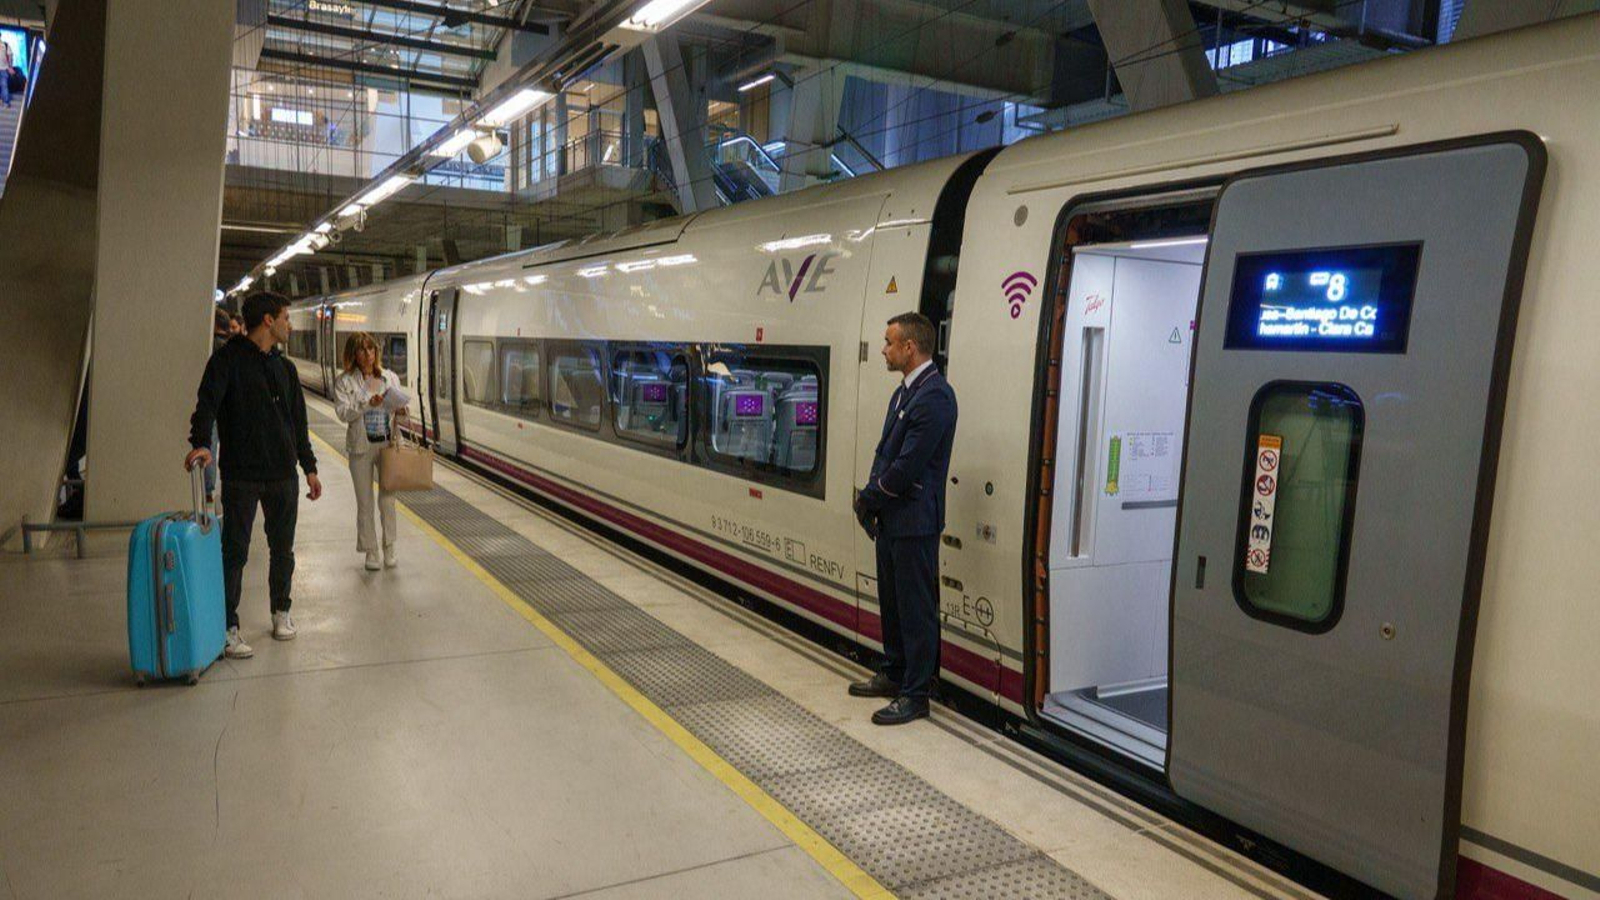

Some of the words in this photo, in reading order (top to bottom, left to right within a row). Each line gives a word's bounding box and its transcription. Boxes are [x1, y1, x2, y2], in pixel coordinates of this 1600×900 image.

[757, 251, 839, 303] AVE
[1327, 273, 1346, 301] 8
[810, 553, 844, 580] RENFV
